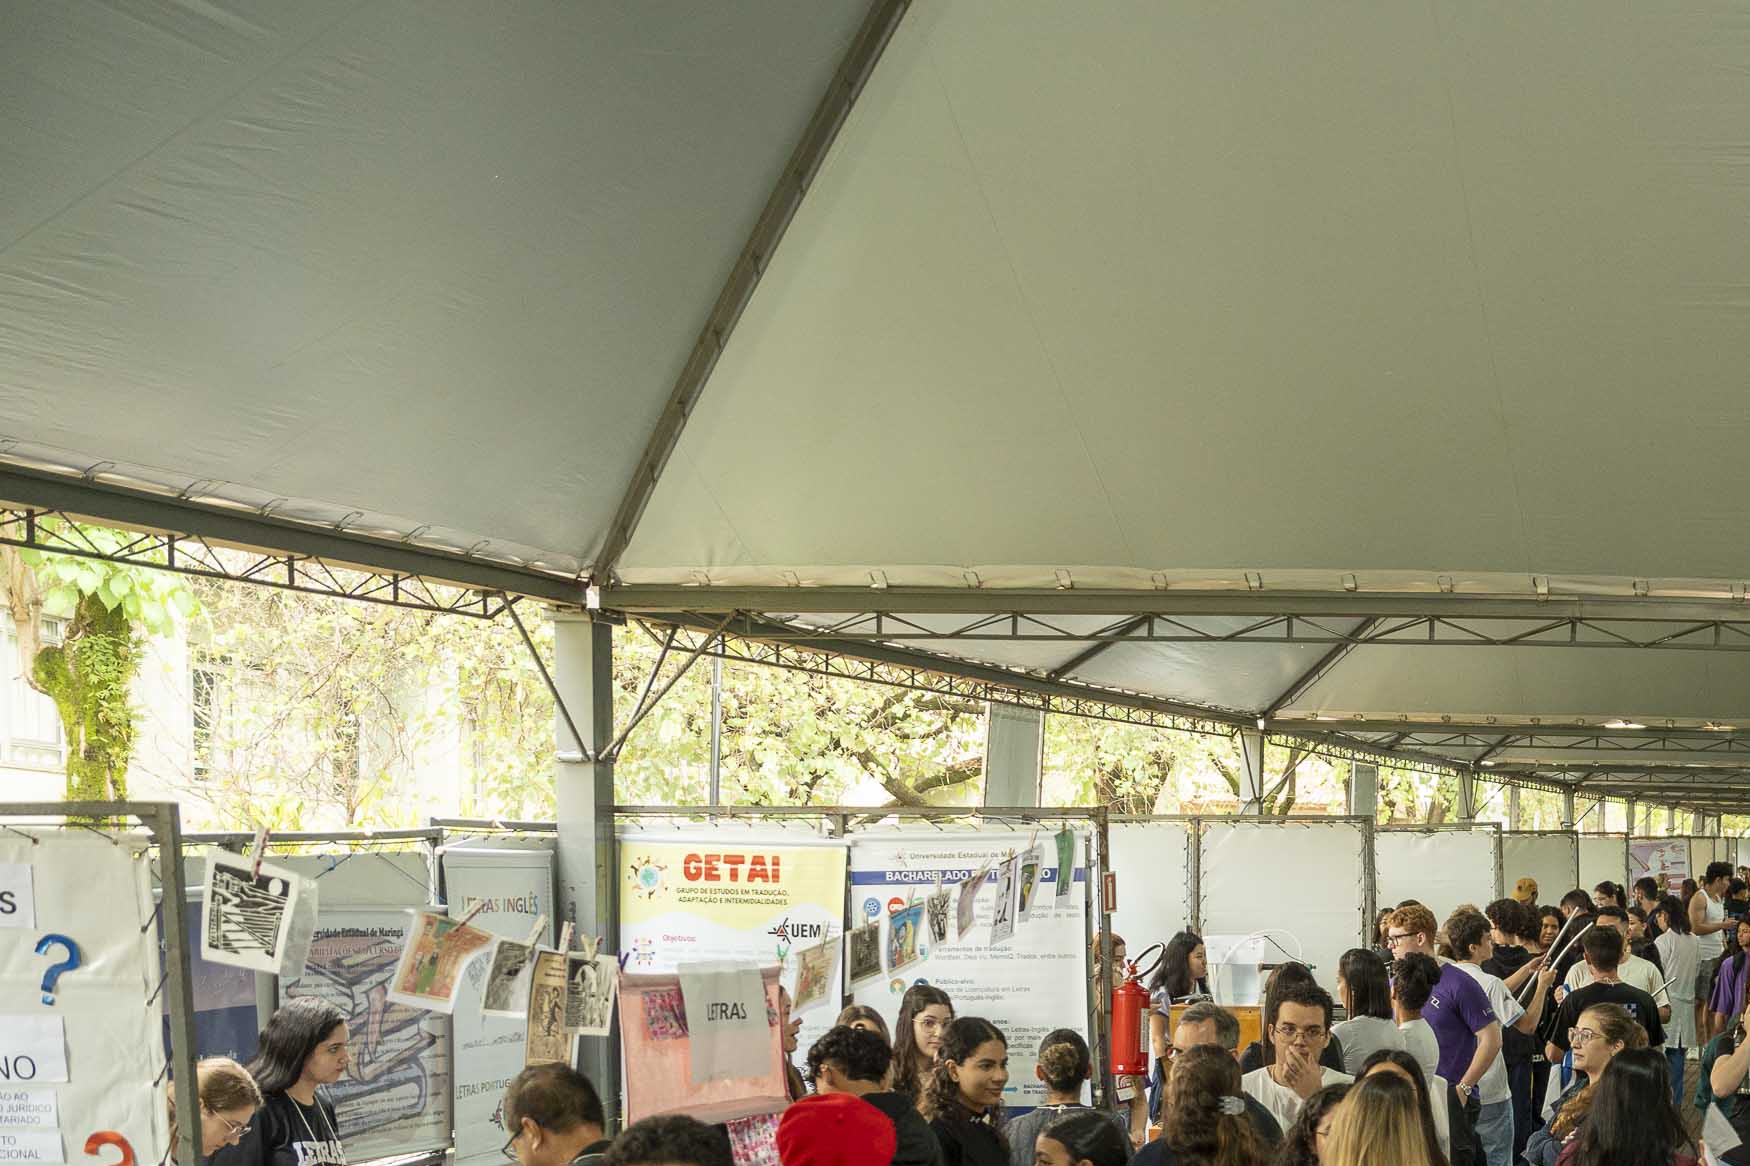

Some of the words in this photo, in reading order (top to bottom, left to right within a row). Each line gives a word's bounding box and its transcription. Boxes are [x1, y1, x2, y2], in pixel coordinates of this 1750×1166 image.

[683, 853, 781, 883] GETAI
[885, 870, 969, 881] BACHARELADO
[709, 888, 740, 896] ESTUDOS
[503, 890, 539, 916] INGLÊS
[678, 896, 718, 905] ADAPTAÇÃO
[379, 927, 403, 939] Maringá
[791, 923, 821, 938] UEM
[706, 1002, 748, 1021] LETRAS
[455, 1083, 480, 1100] LETRAS
[480, 1078, 512, 1093] PORTUG
